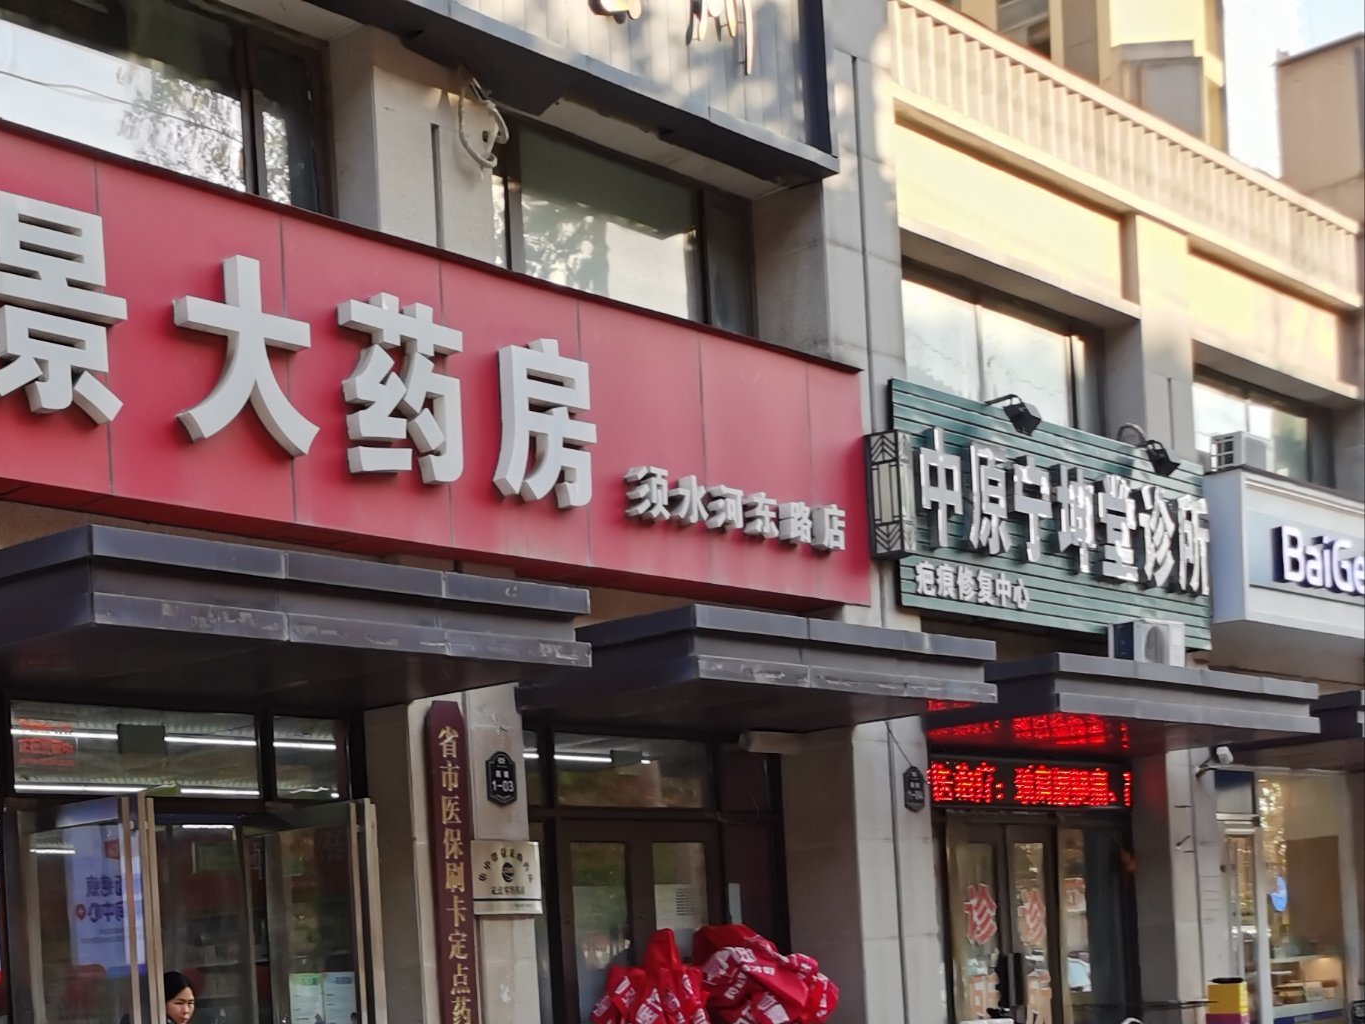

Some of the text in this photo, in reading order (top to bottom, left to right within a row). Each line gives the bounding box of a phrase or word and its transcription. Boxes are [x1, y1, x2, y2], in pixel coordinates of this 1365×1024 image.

[626, 466, 846, 553] 须水河东路店
[915, 560, 1030, 610] 疤痕修复中心
